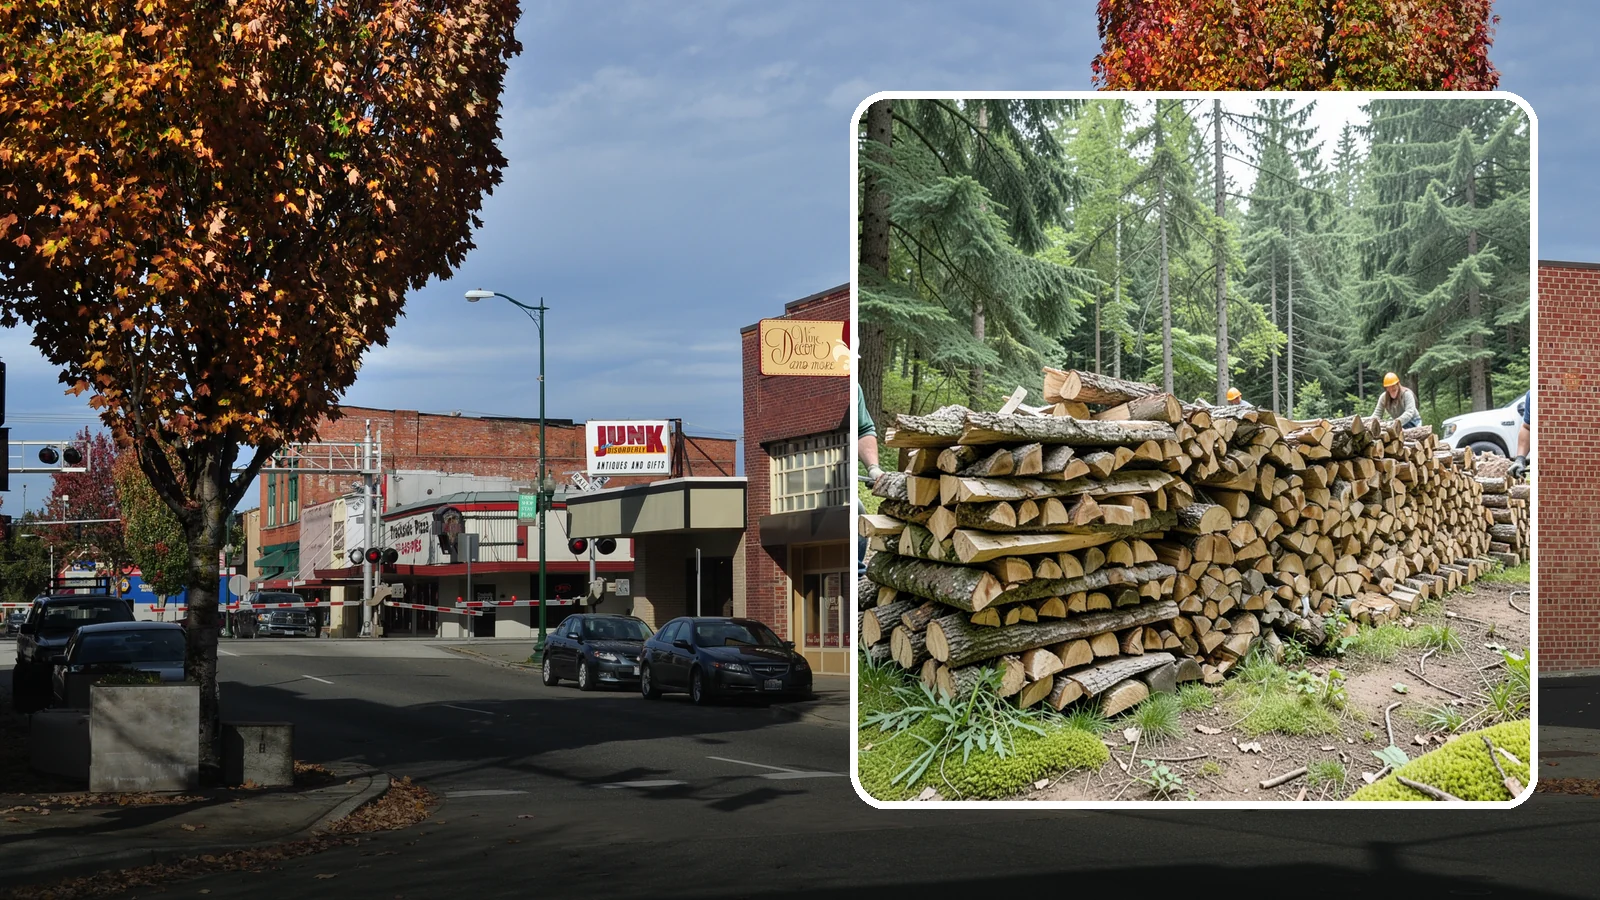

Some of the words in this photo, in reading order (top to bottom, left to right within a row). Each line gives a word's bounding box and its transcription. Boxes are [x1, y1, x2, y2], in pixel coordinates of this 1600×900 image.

[765, 327, 831, 365] Decor
[595, 425, 665, 457] JUNK
[607, 446, 646, 454] DISORDERLY
[596, 461, 628, 470] ANTIQUES
[631, 461, 644, 470] AND
[647, 460, 665, 469] GIFTS
